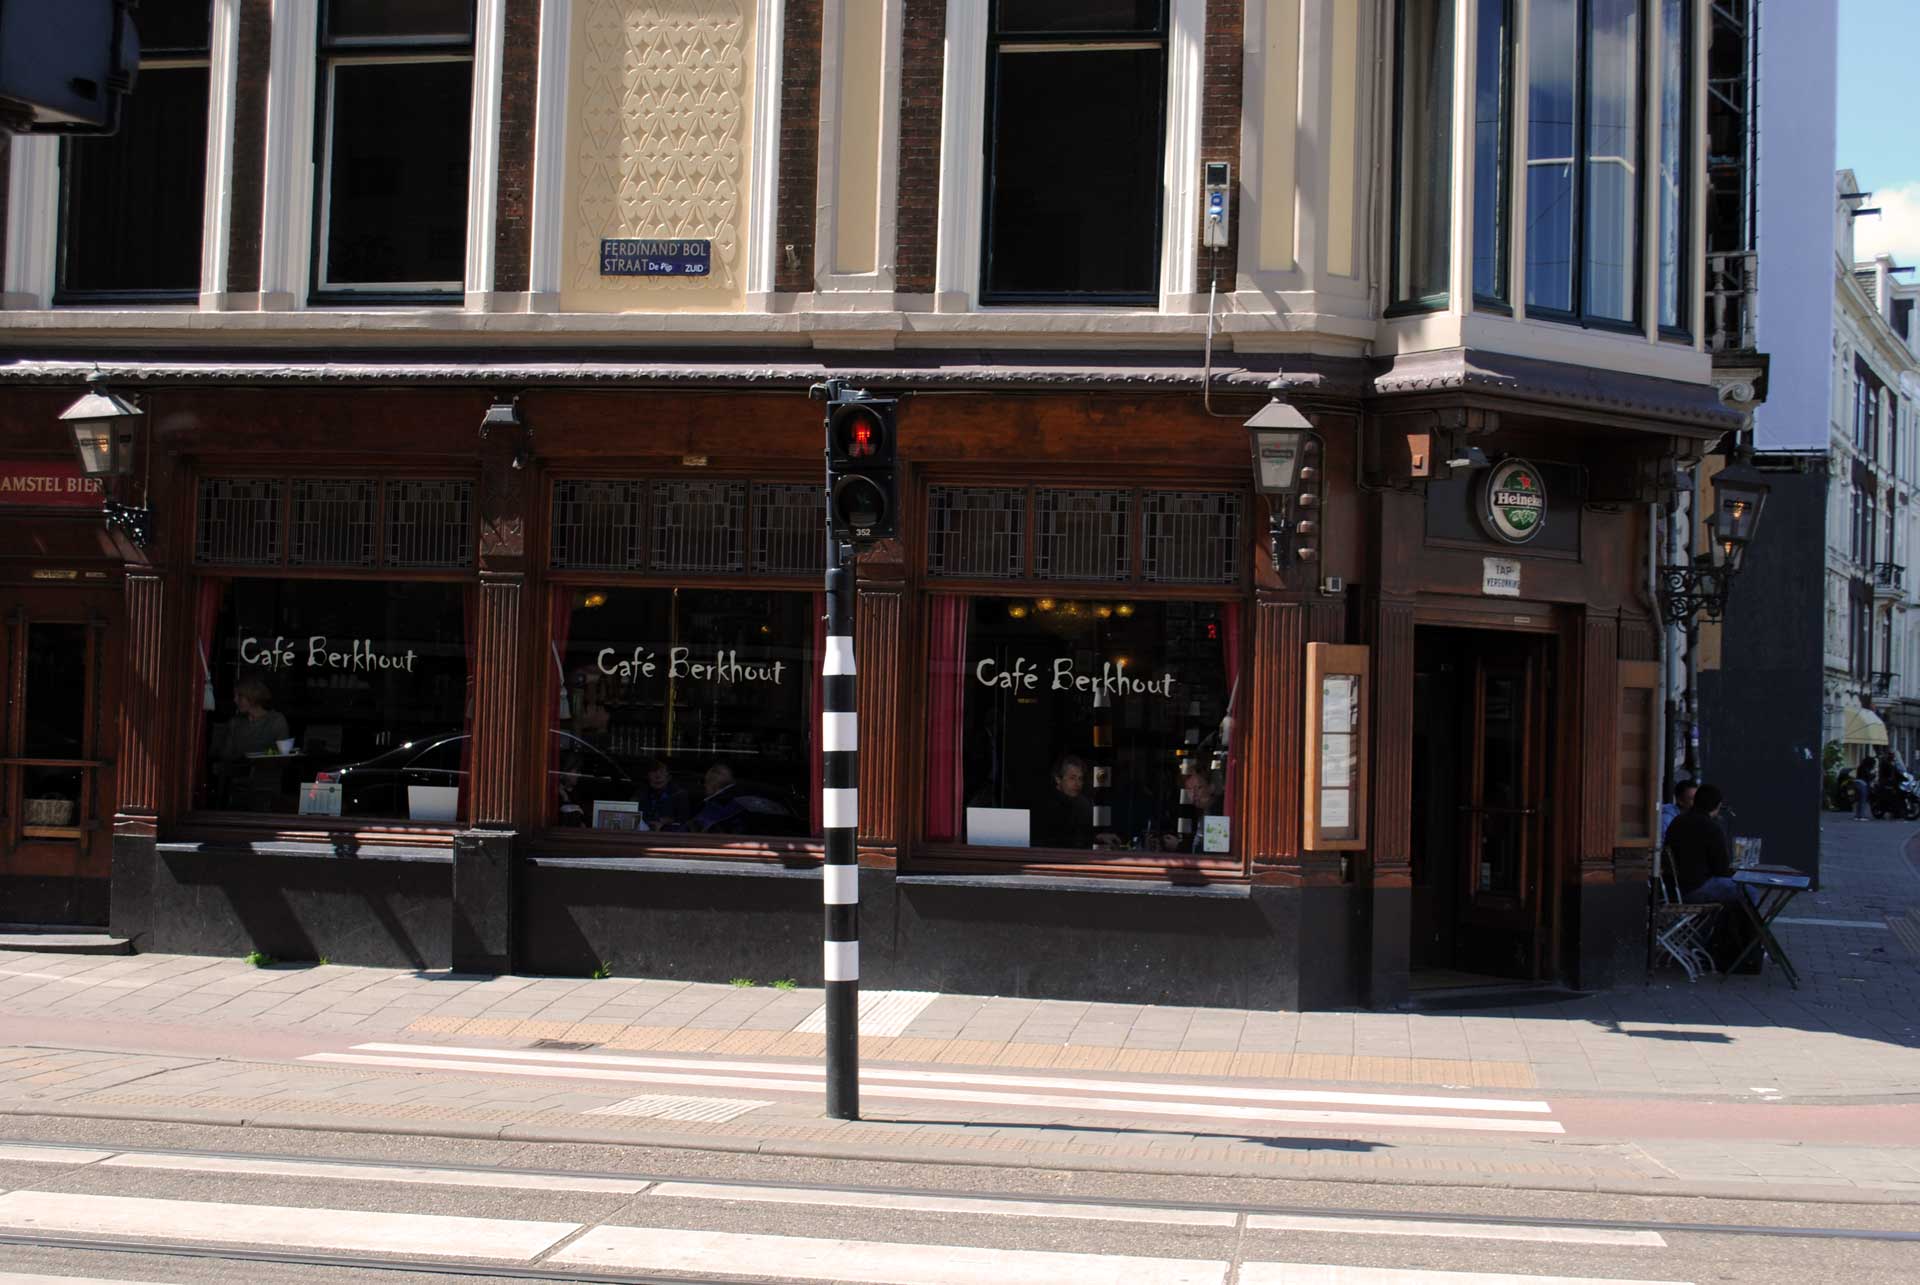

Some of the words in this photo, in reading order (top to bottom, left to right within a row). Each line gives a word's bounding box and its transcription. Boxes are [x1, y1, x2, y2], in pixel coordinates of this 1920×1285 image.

[604, 242, 677, 256] FERDINAND
[683, 243, 706, 256] BOL
[604, 259, 648, 272] STRAAT
[649, 262, 659, 271] De
[685, 264, 704, 273] ZUID
[0, 476, 63, 492] AMSTEL
[66, 478, 103, 492] BIER
[856, 528, 871, 537] 352
[240, 636, 295, 672] Café
[307, 636, 418, 672] Berkhout
[597, 646, 656, 684] Café
[668, 647, 786, 685] Berkhout
[976, 657, 1039, 696] Café
[1051, 657, 1176, 698] Berkhout
